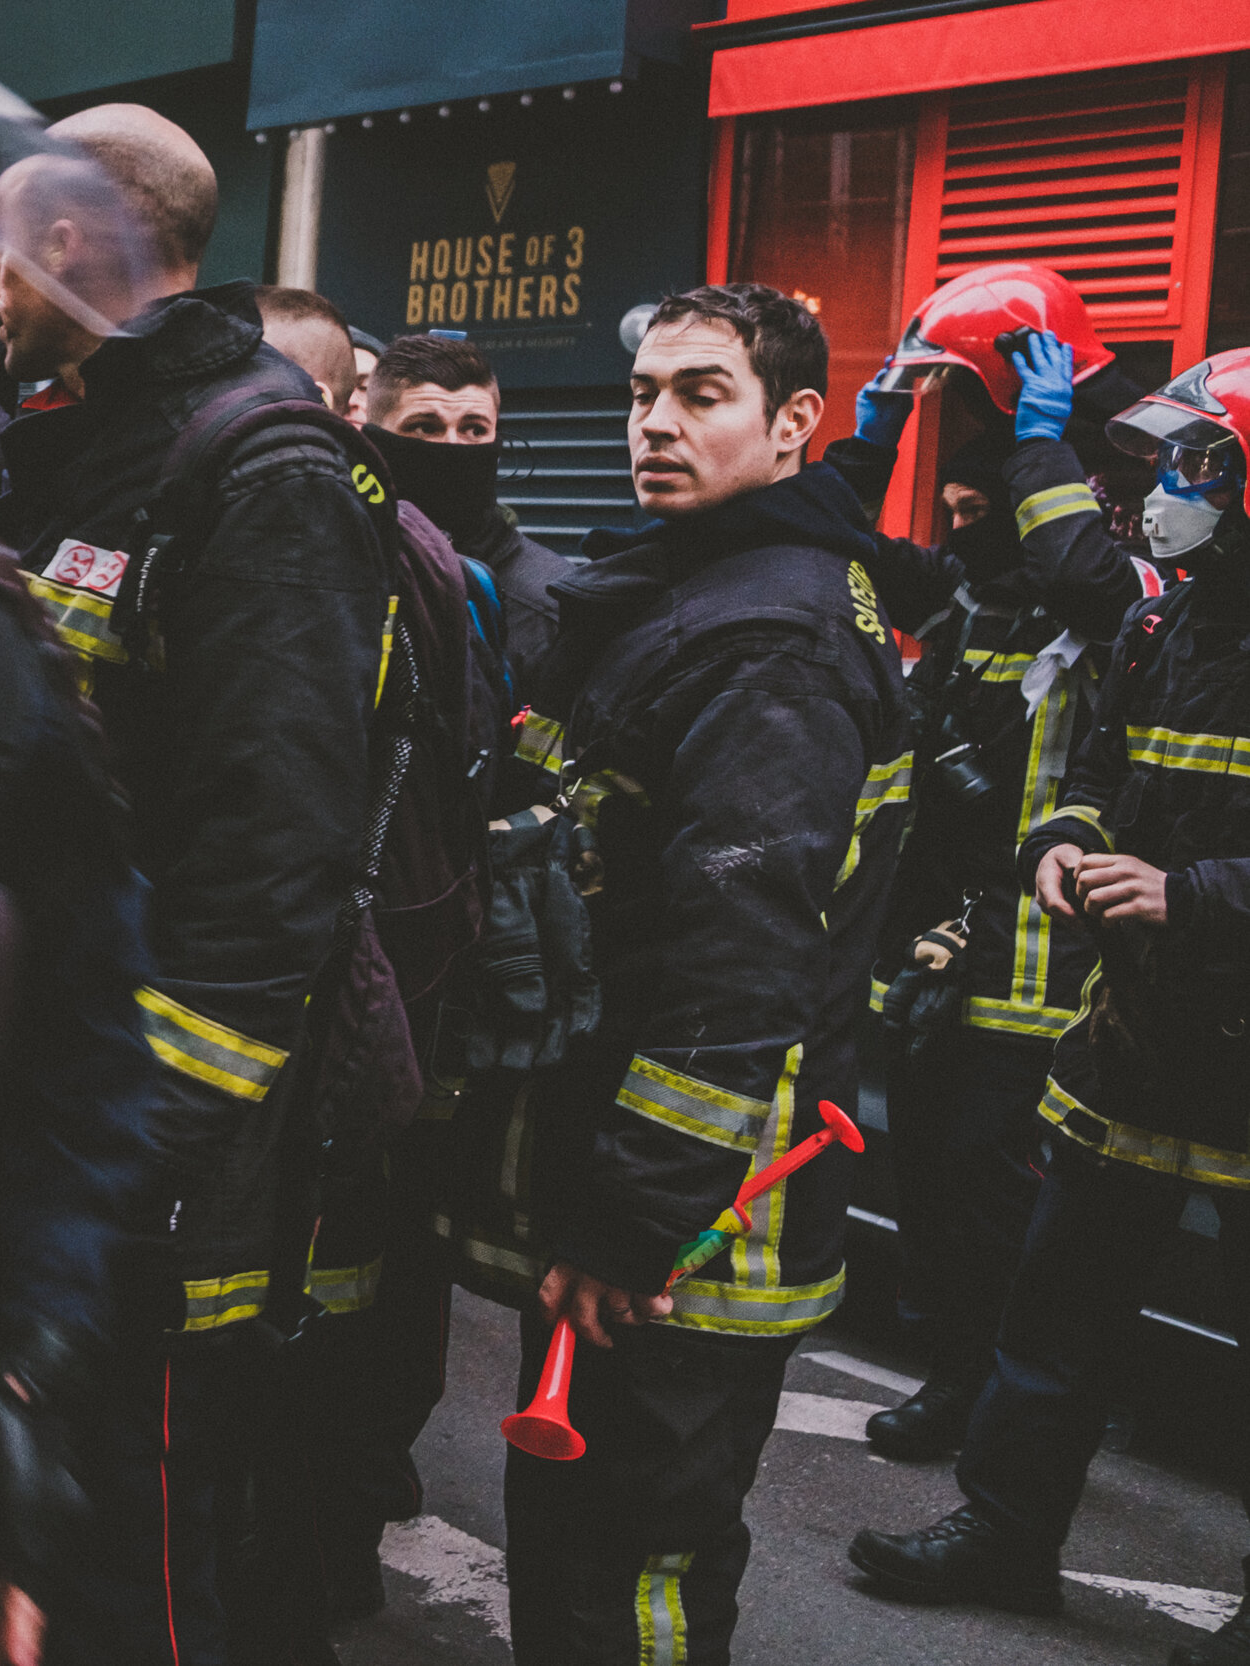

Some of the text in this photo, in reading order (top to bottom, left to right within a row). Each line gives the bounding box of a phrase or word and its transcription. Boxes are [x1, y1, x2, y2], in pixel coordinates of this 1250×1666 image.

[409, 225, 586, 281] HOUSE OF 3
[406, 272, 582, 326] BROTHERS
